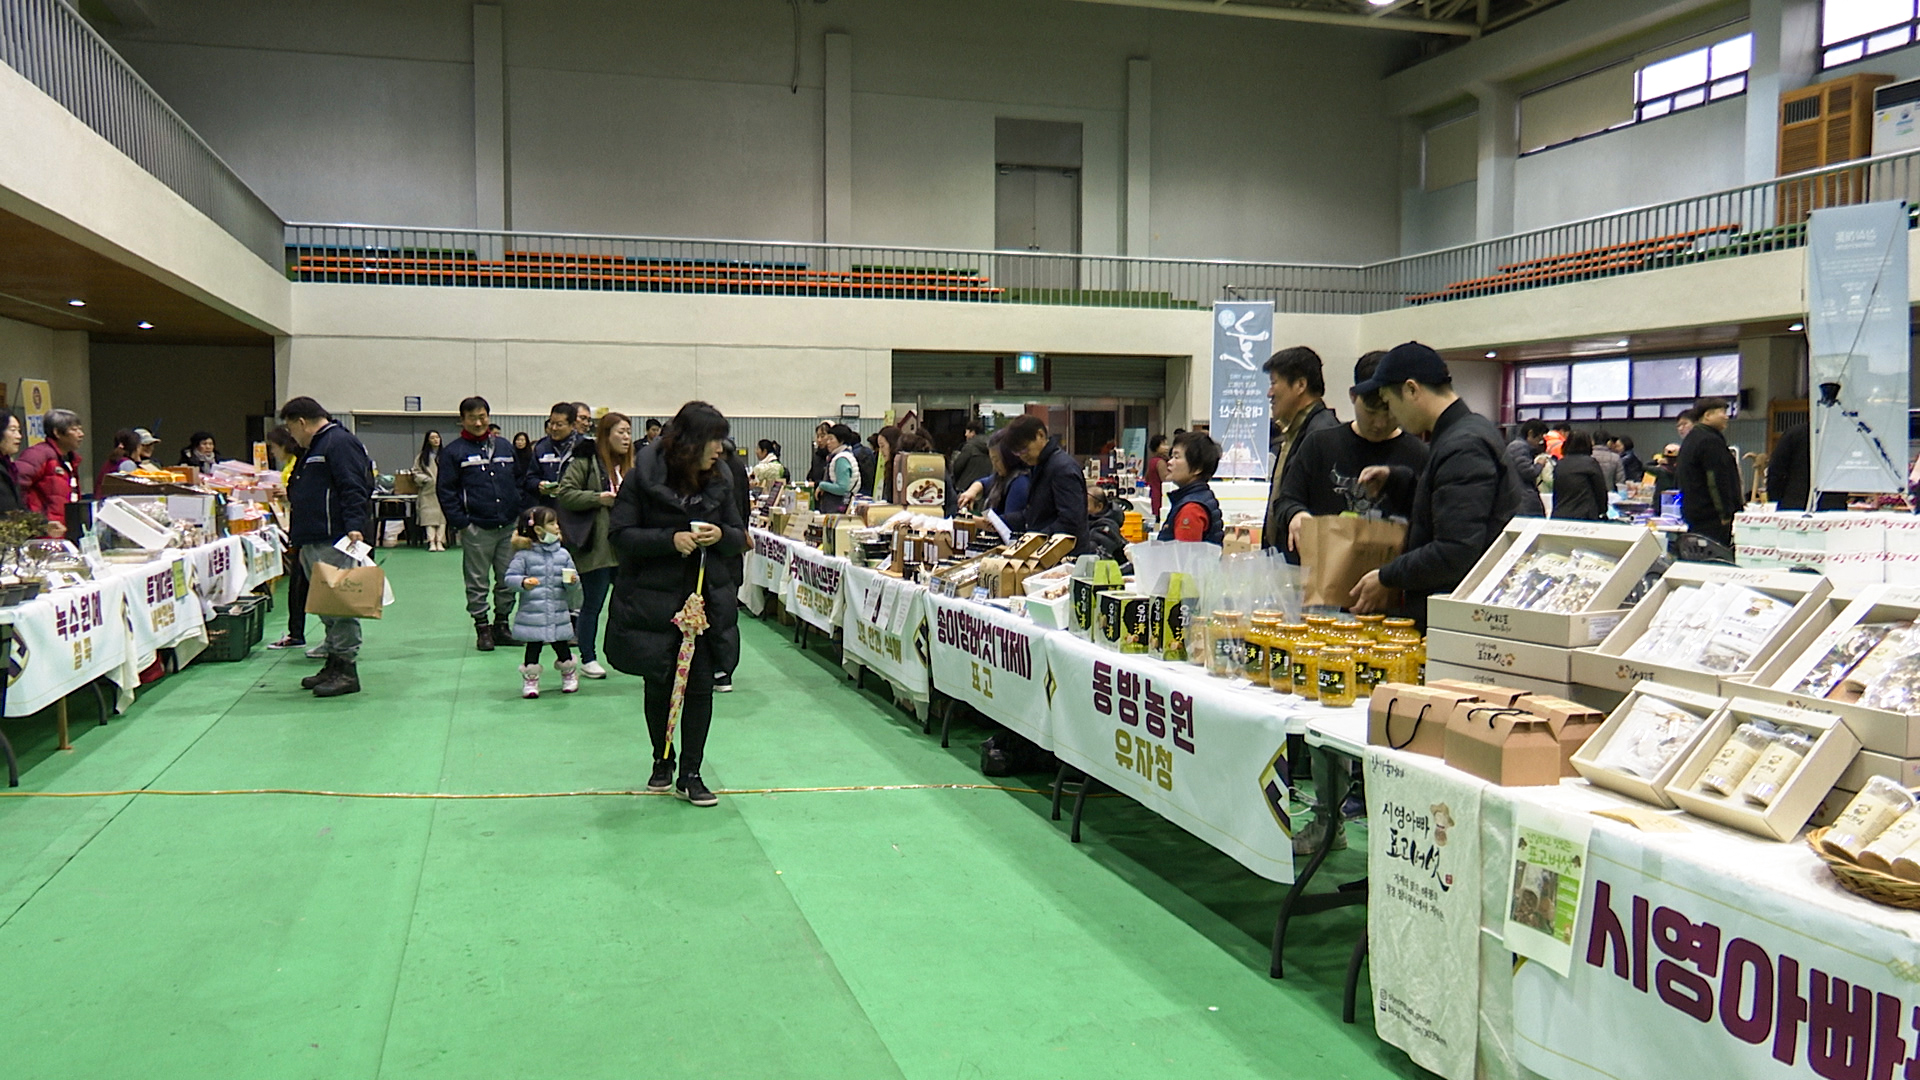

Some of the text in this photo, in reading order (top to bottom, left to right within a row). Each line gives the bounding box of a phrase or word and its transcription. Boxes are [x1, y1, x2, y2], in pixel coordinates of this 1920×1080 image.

[971, 661, 993, 699] 표고
[1093, 660, 1195, 754] 동방농원
[1115, 728, 1173, 792] 유자청
[1382, 801, 1430, 839] 시영아빠
[1528, 846, 1575, 875] 표고버섯
[1586, 880, 1920, 1080] 시영아빠
